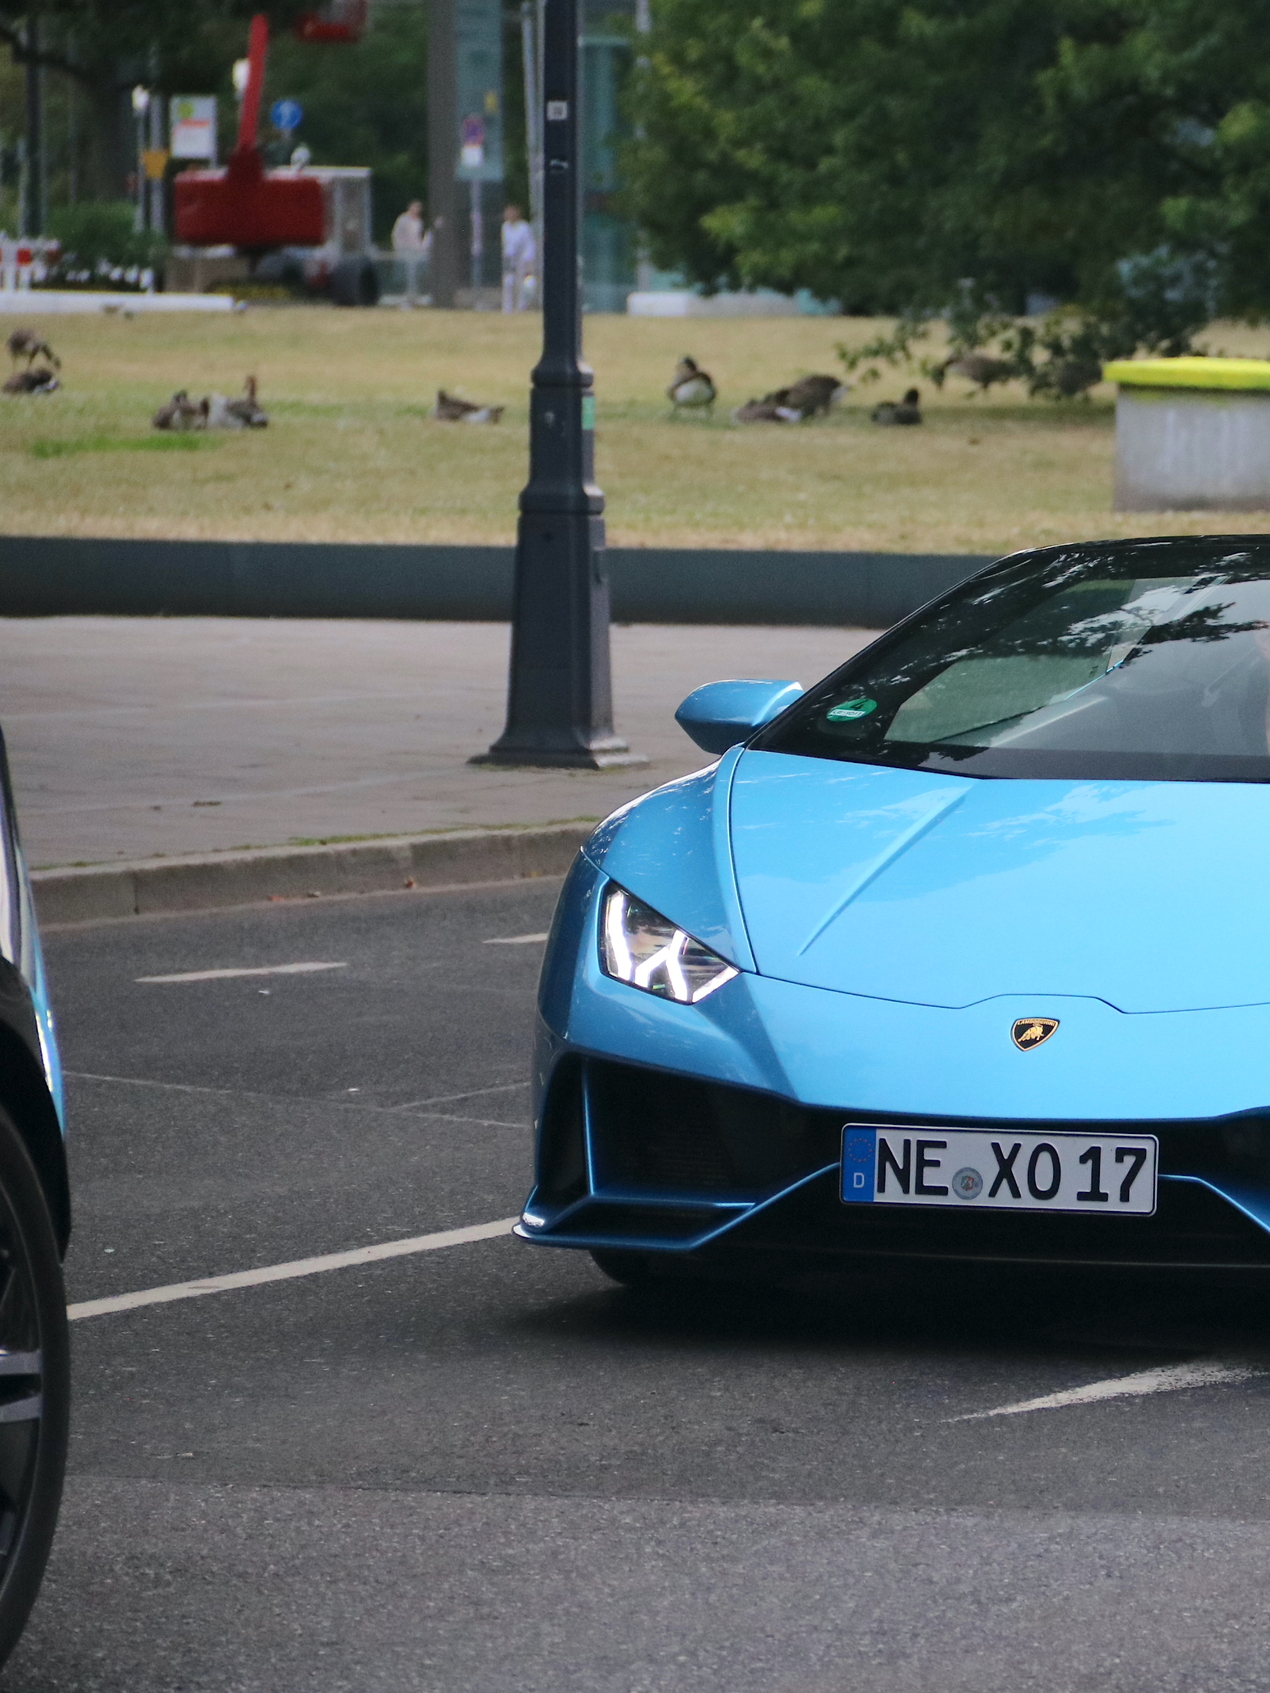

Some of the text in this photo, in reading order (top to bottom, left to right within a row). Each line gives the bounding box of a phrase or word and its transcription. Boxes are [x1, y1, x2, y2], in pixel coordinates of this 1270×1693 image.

[850, 699, 869, 710] 4
[877, 1138, 1148, 1203] NE XO 17
[853, 1172, 865, 1188] D
